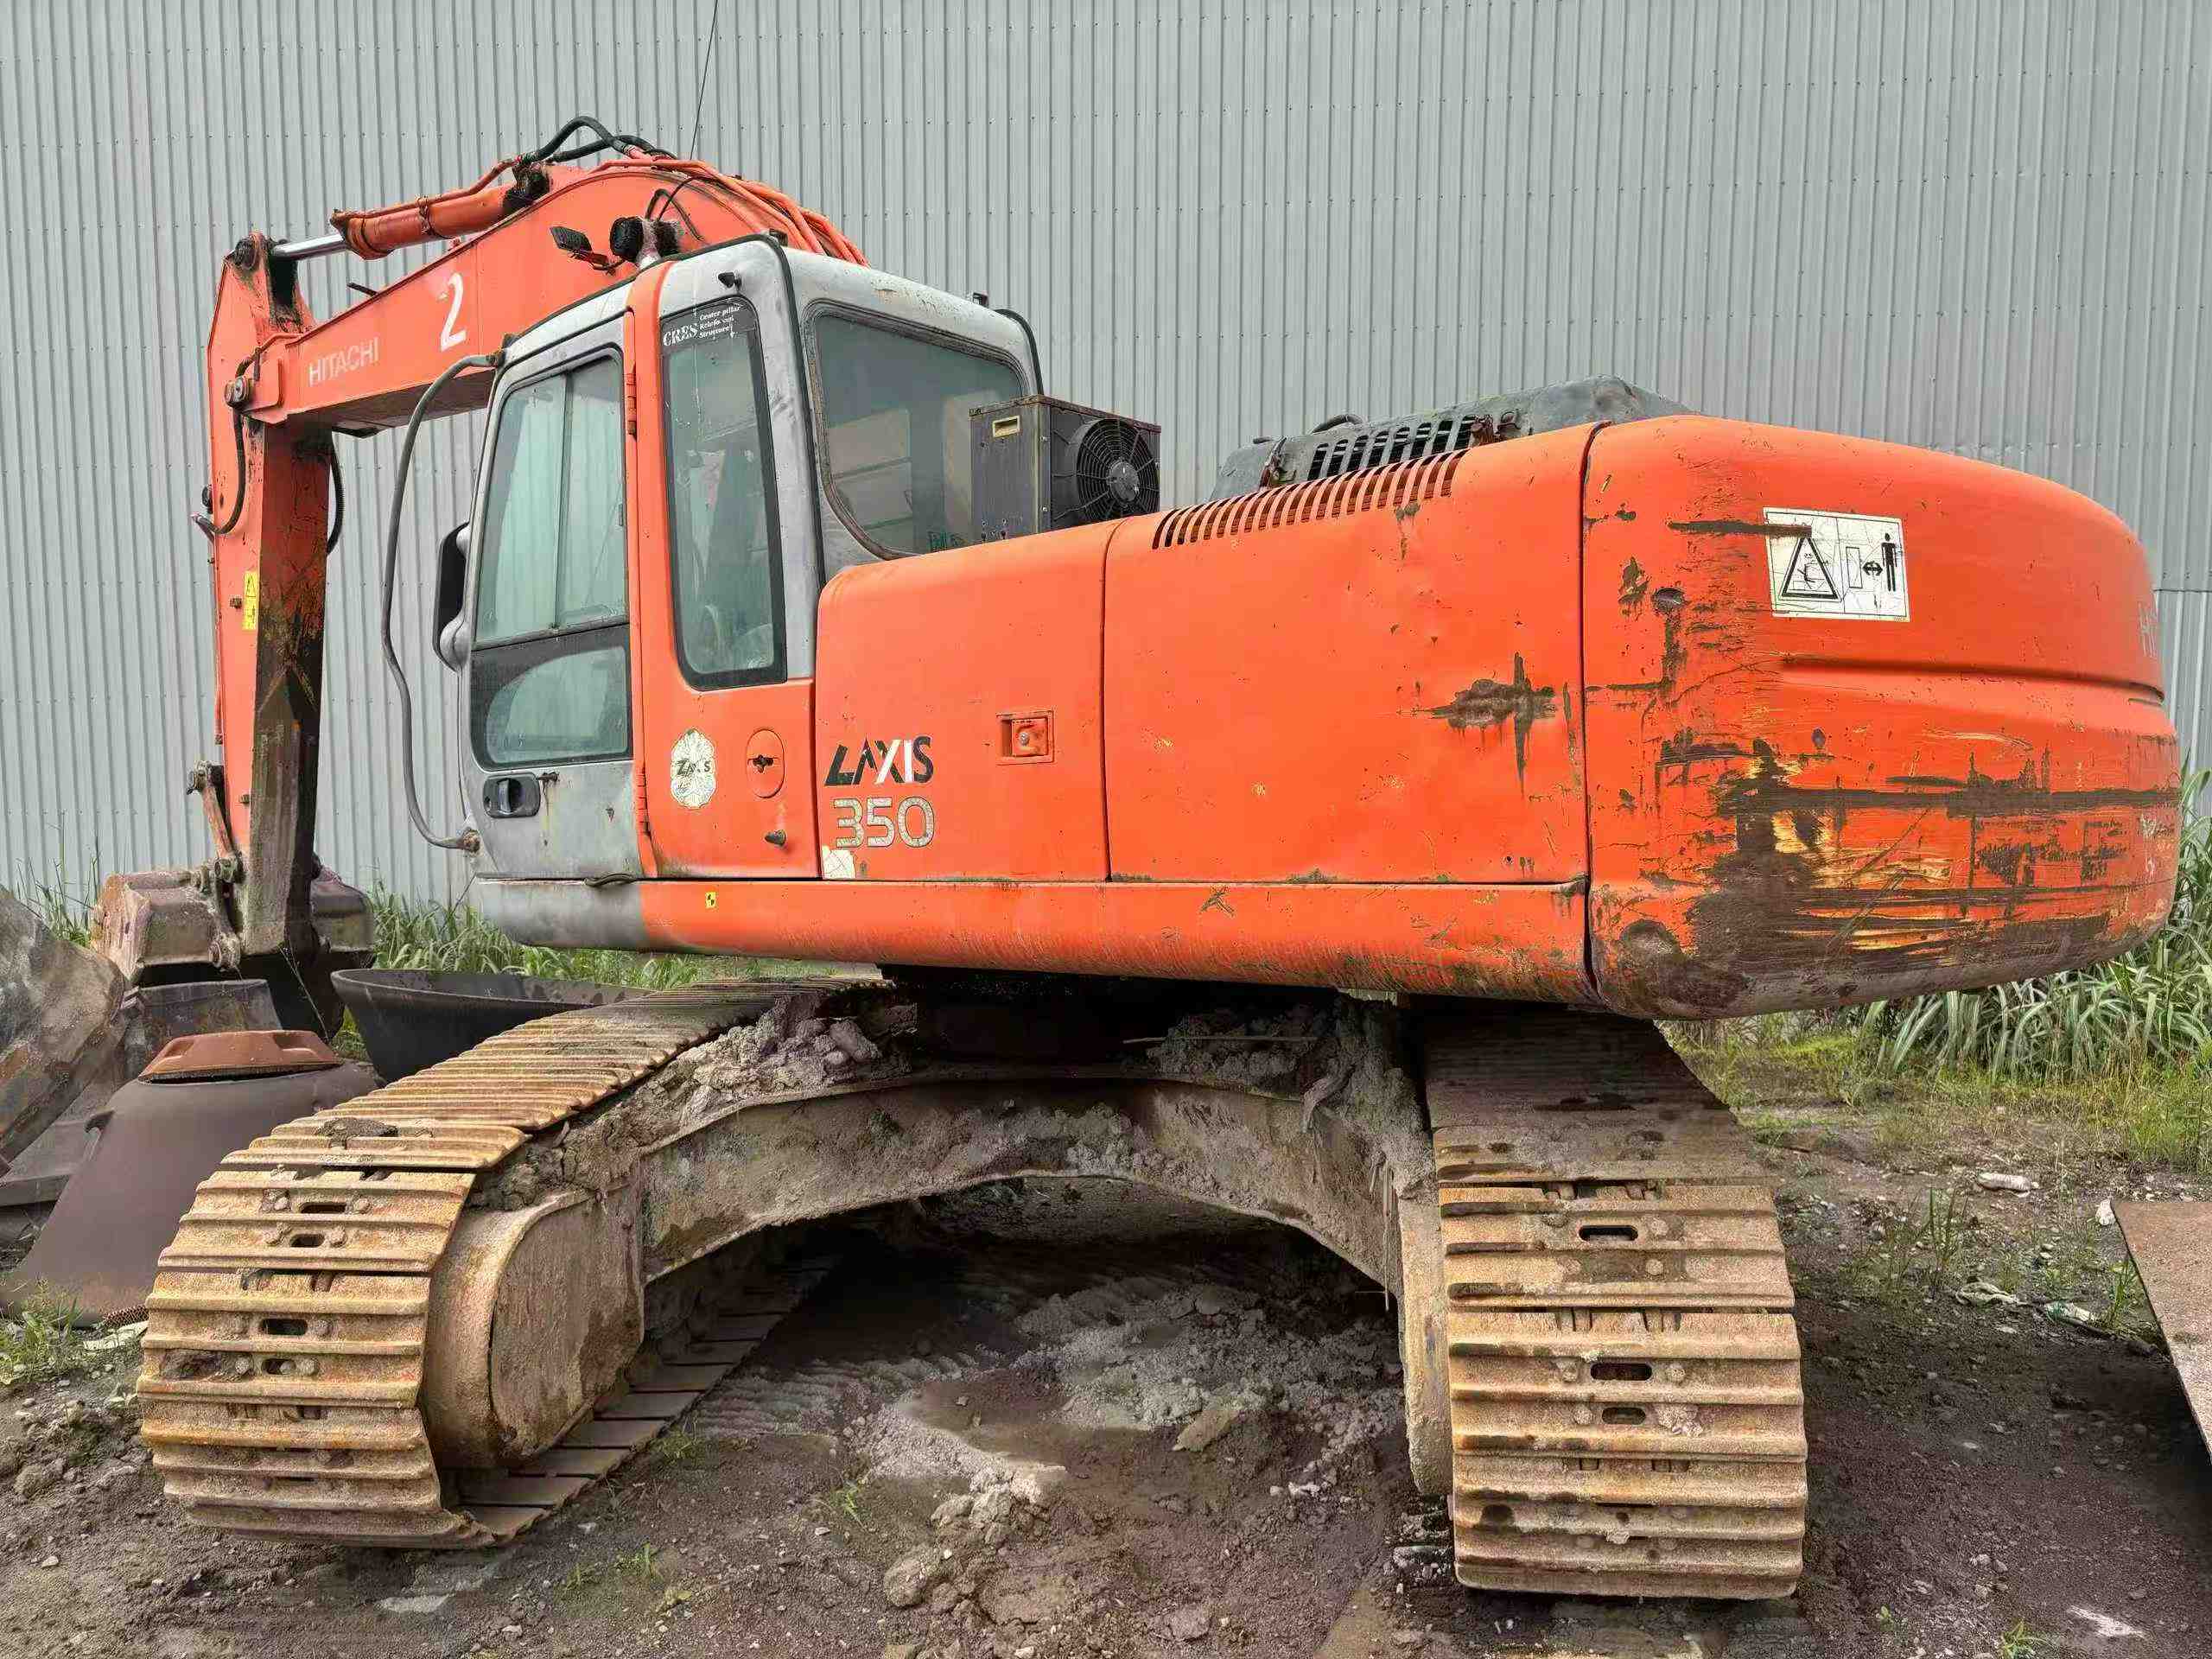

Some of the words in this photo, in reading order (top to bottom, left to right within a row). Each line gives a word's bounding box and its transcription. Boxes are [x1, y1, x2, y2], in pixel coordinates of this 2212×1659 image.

[439, 273, 467, 352] 2
[663, 322, 699, 346] CRES
[308, 337, 379, 388] HITACHI
[834, 797, 935, 849] 350
